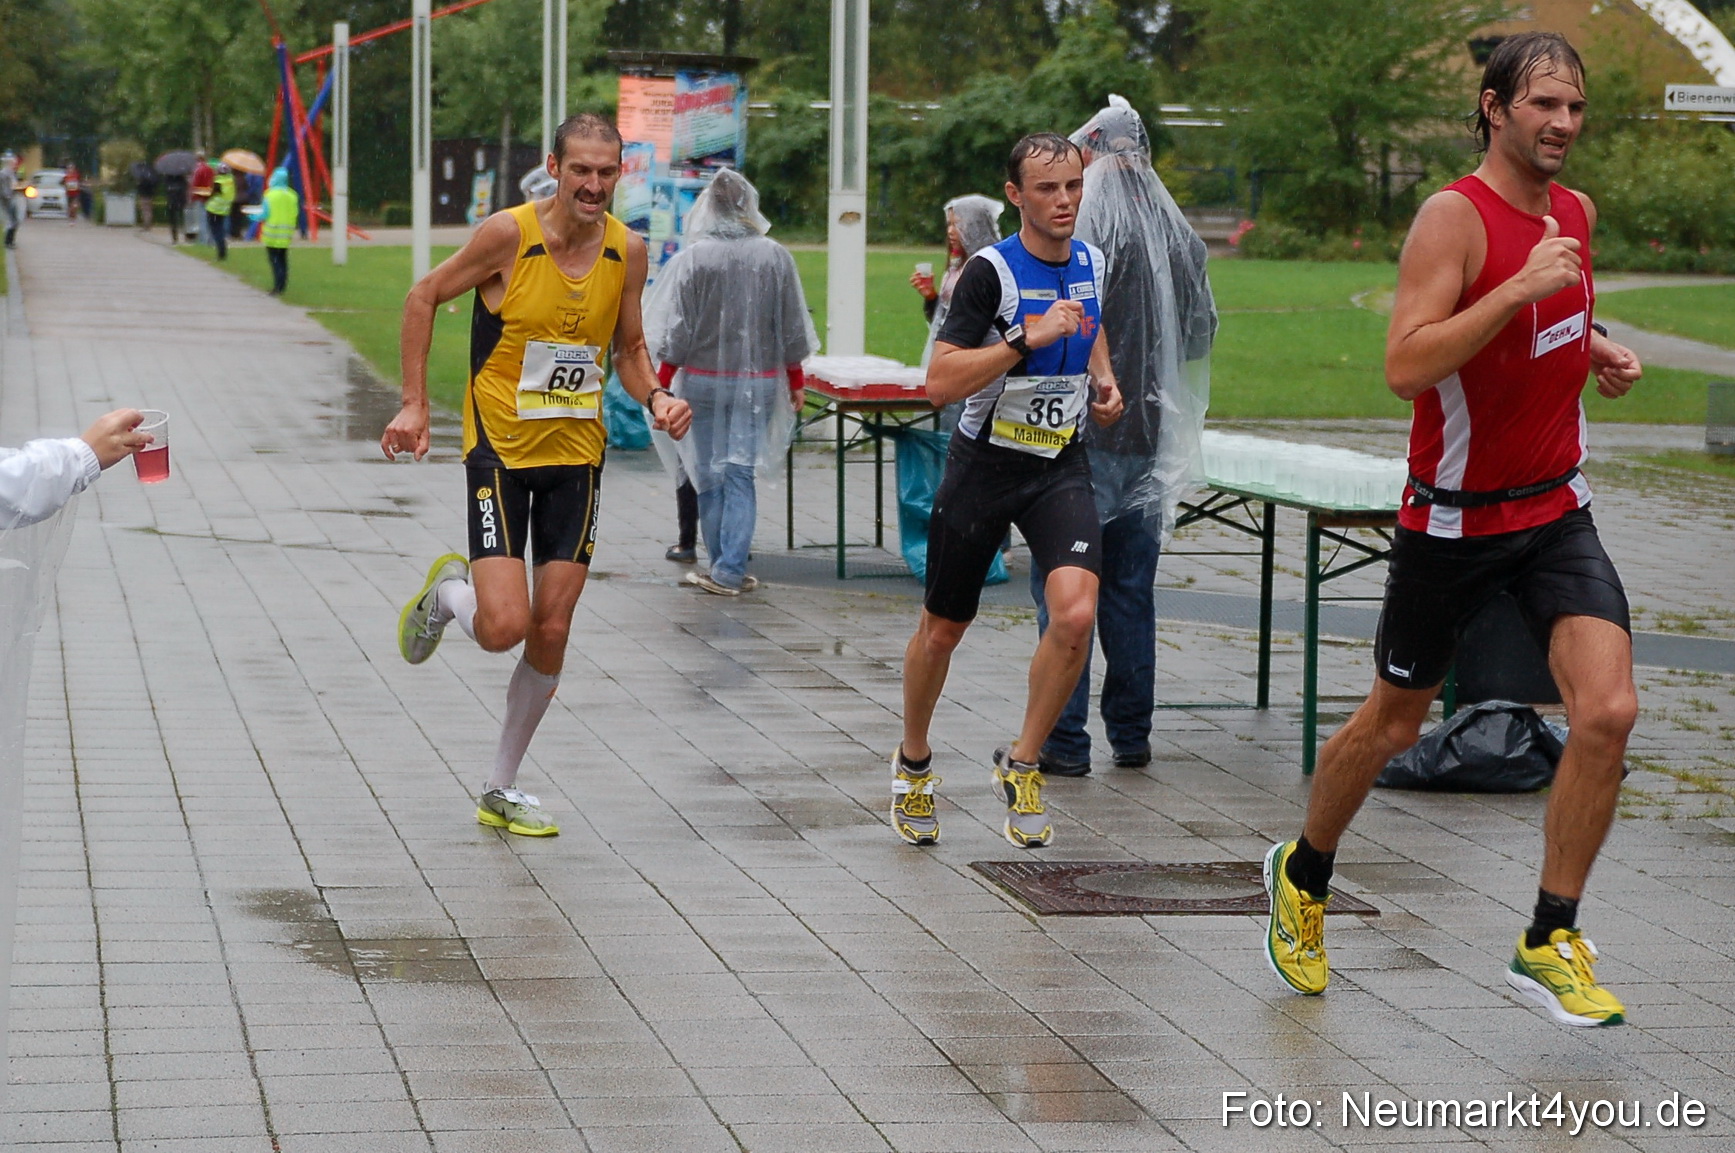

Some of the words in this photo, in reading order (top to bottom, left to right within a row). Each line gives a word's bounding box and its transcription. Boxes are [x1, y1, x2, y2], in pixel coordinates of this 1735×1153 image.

[1548, 325, 1572, 344] DEHN
[555, 350, 589, 360] BOCK
[548, 366, 586, 393] 69
[541, 391, 583, 406] Thom
[1026, 398, 1064, 428] 36
[1014, 428, 1067, 446] Matthias
